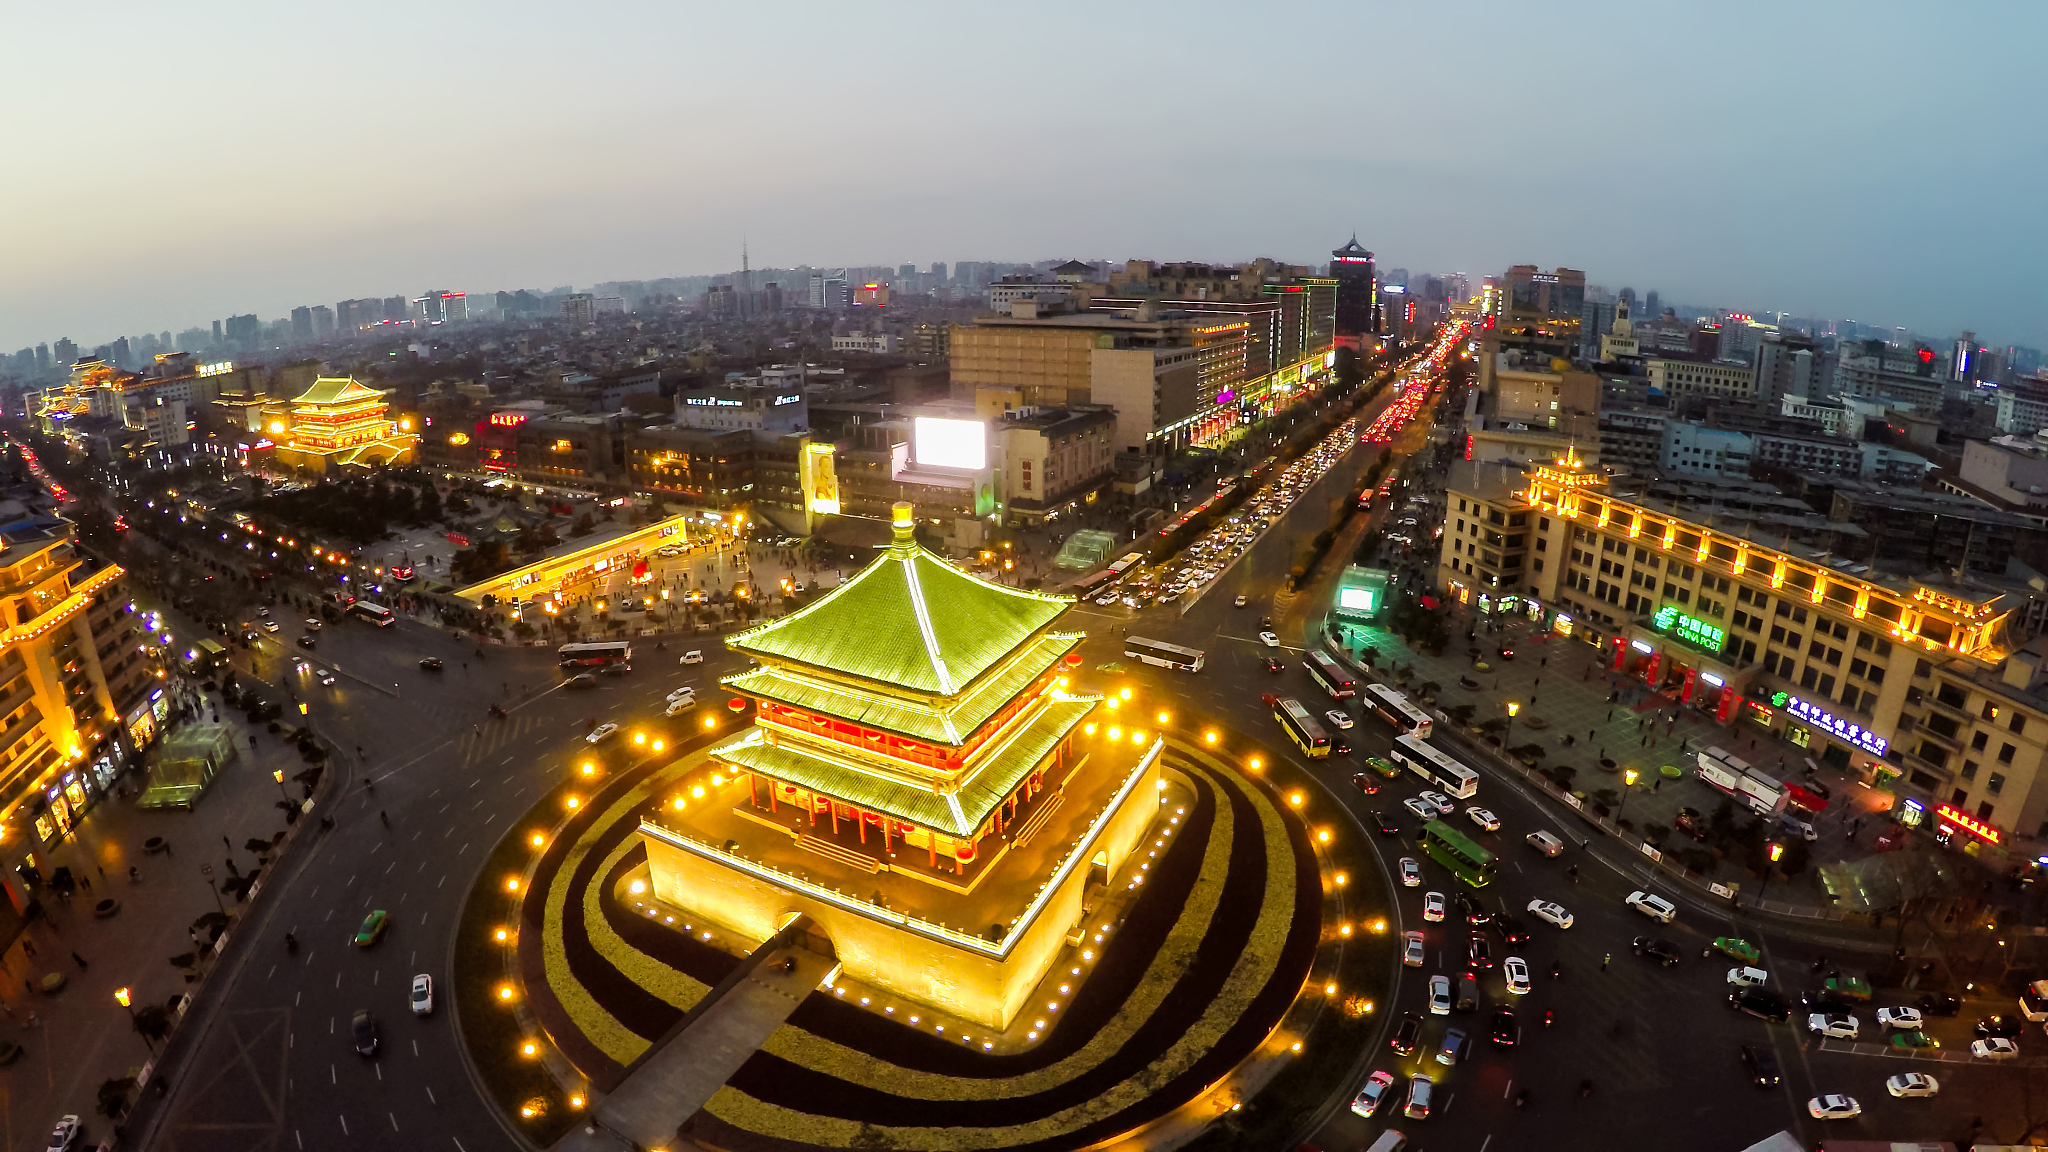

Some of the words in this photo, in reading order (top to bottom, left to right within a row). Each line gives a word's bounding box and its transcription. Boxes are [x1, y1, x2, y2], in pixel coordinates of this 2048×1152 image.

[1676, 627, 1699, 643] CHINA
[1700, 637, 1721, 651] POST
[1679, 615, 1724, 642] 中国邮政
